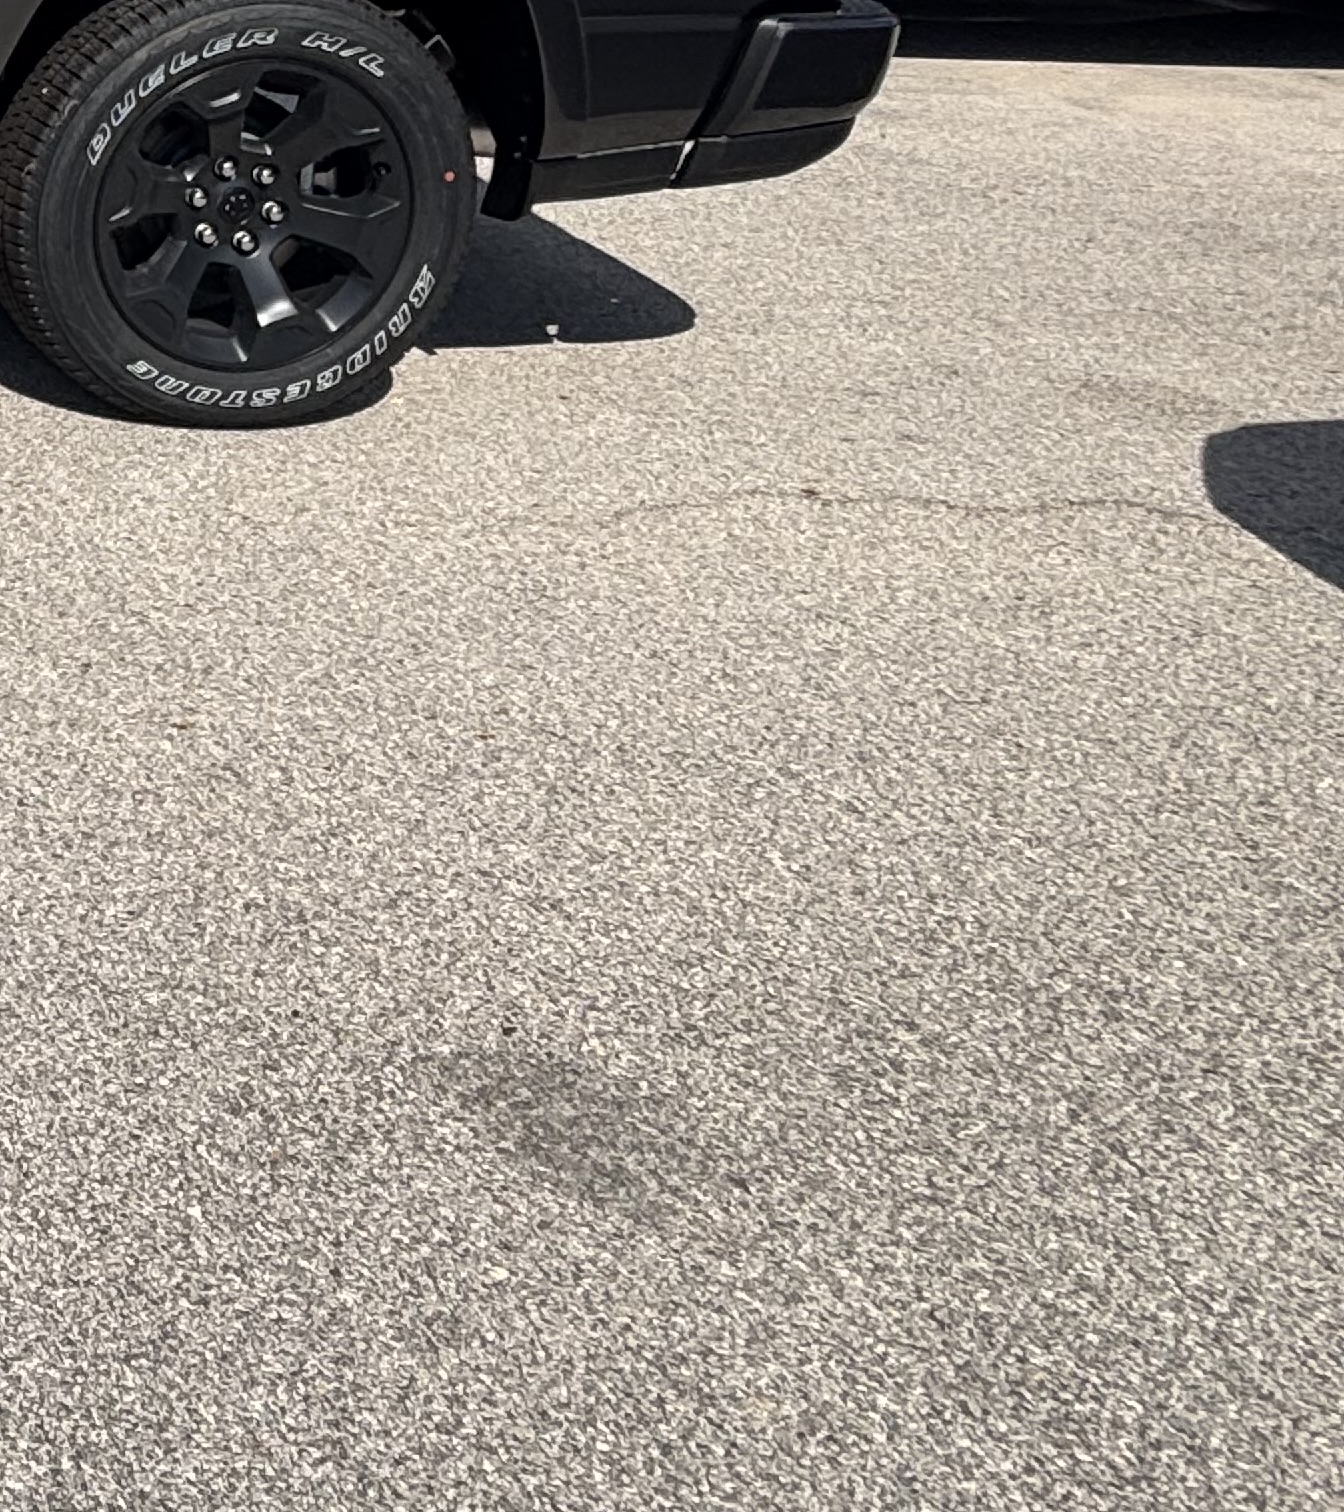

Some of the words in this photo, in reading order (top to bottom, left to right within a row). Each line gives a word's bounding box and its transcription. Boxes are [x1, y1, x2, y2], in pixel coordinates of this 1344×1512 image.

[85, 27, 279, 167] DUELER
[300, 29, 389, 80] H/L
[126, 263, 438, 410] BRIDGESTONE
